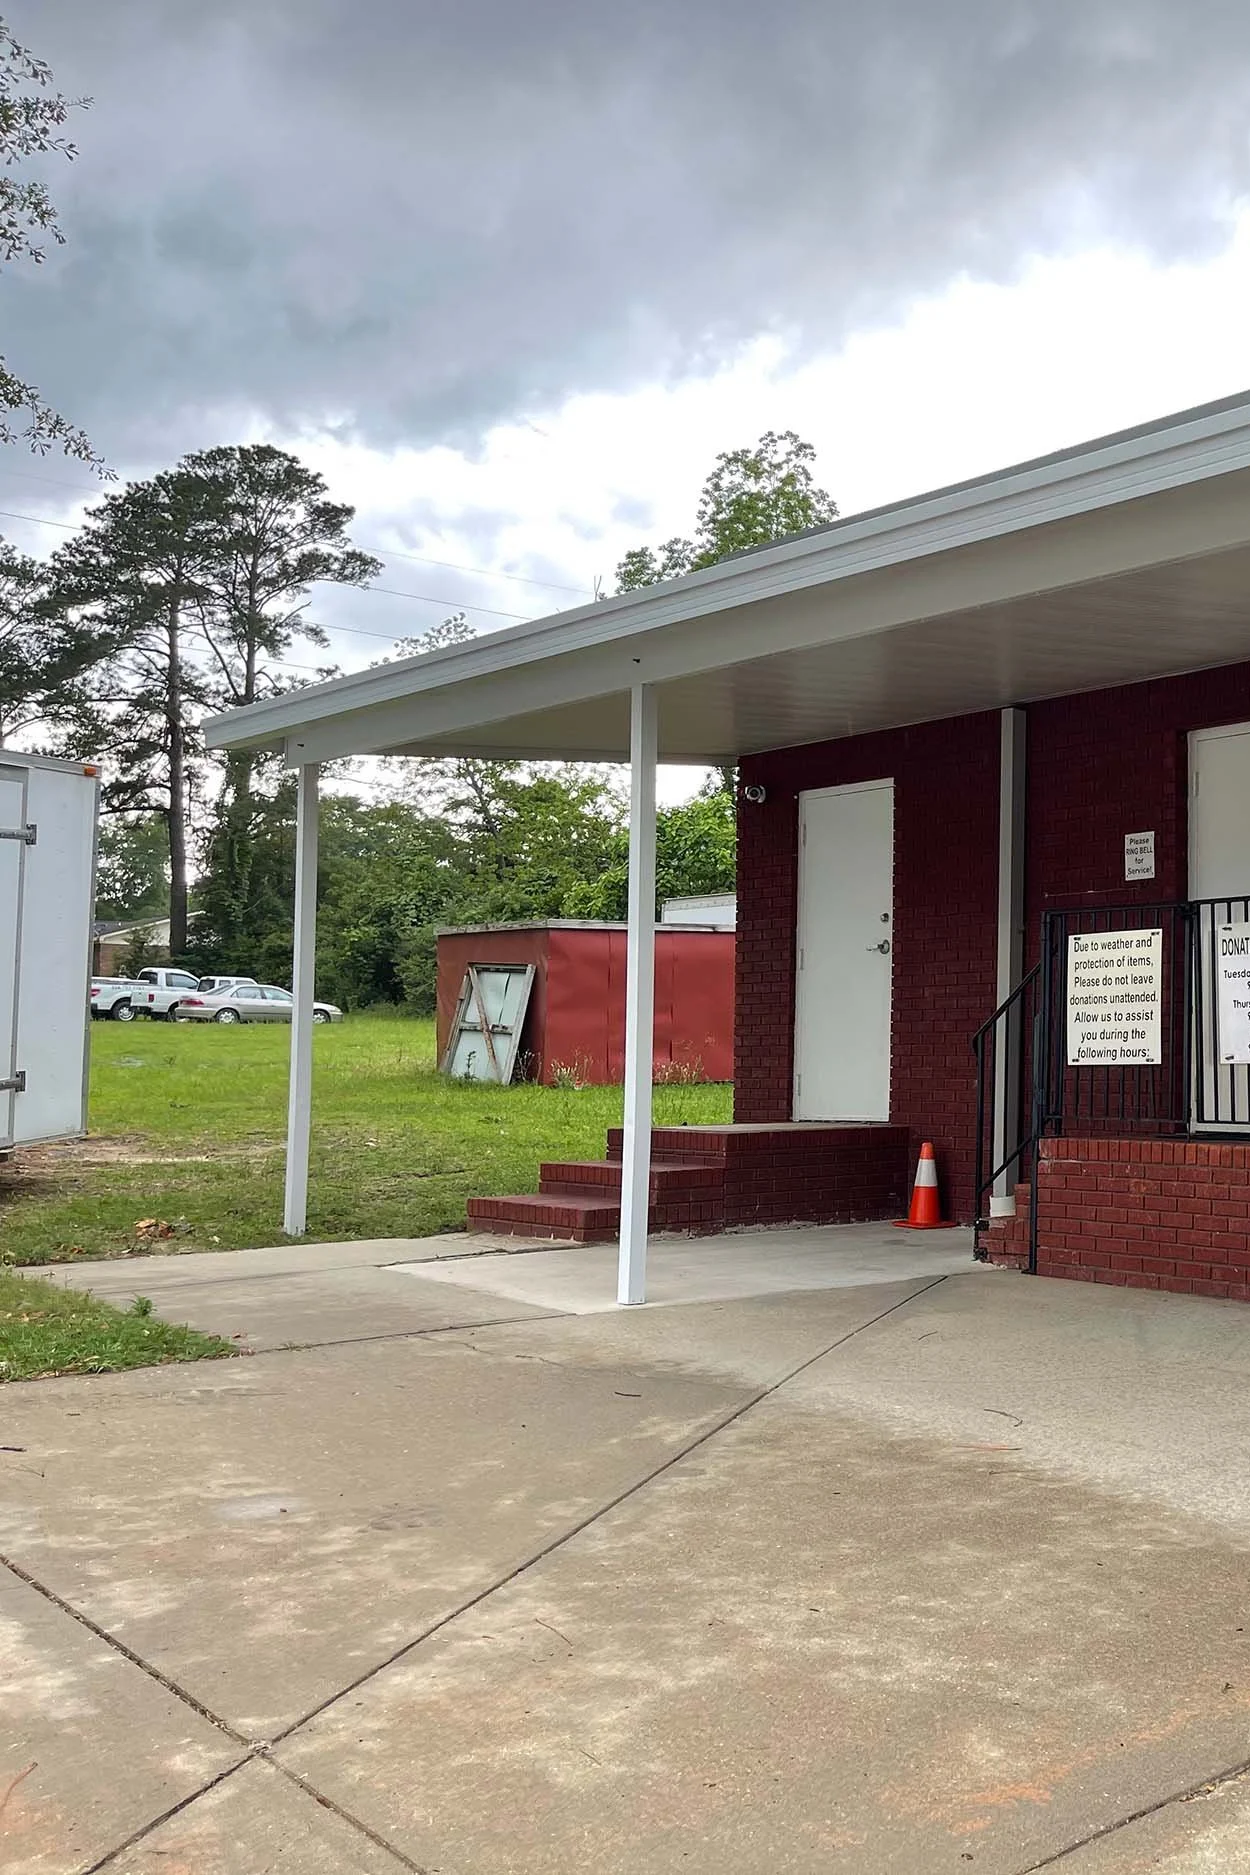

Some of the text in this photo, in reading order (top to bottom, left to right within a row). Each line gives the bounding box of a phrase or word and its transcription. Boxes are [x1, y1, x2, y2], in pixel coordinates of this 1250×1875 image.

[1074, 937, 1152, 952] Due to weather and
[1074, 955, 1153, 972] protection of items,
[1074, 974, 1153, 987] Please do not leave
[1070, 991, 1158, 1005] donations unattended.
[1074, 1010, 1153, 1023] Allow us to assist
[1081, 1028, 1146, 1043] you during the
[1078, 1047, 1150, 1060] following hours:
